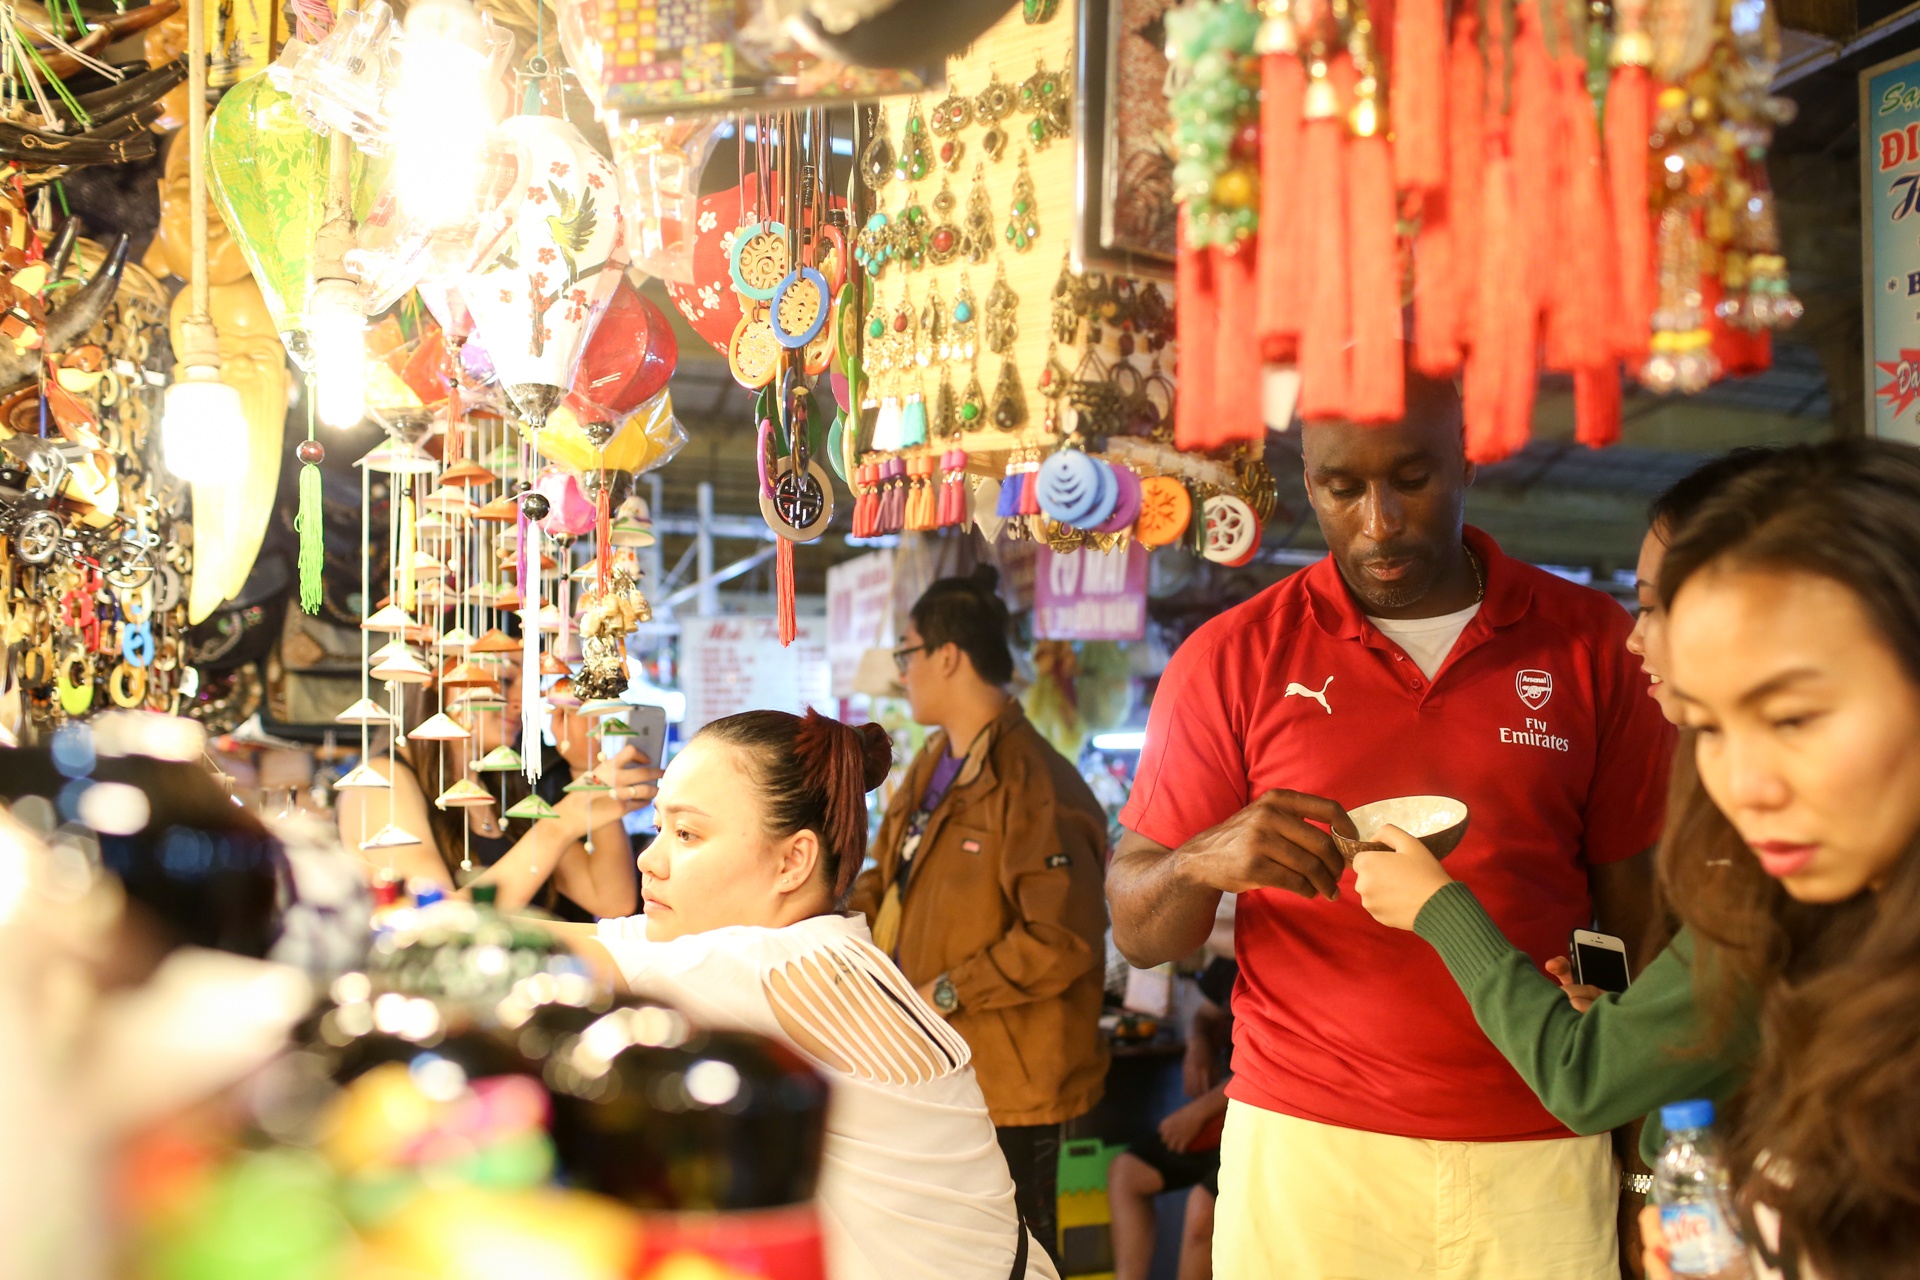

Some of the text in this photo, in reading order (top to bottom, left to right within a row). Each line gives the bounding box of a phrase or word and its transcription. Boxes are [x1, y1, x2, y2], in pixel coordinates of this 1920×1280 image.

[1880, 83, 1920, 114] Sạ
[1522, 675, 1547, 684] Arsenal
[1525, 717, 1547, 732] Fly
[1499, 727, 1569, 752] Emirates
